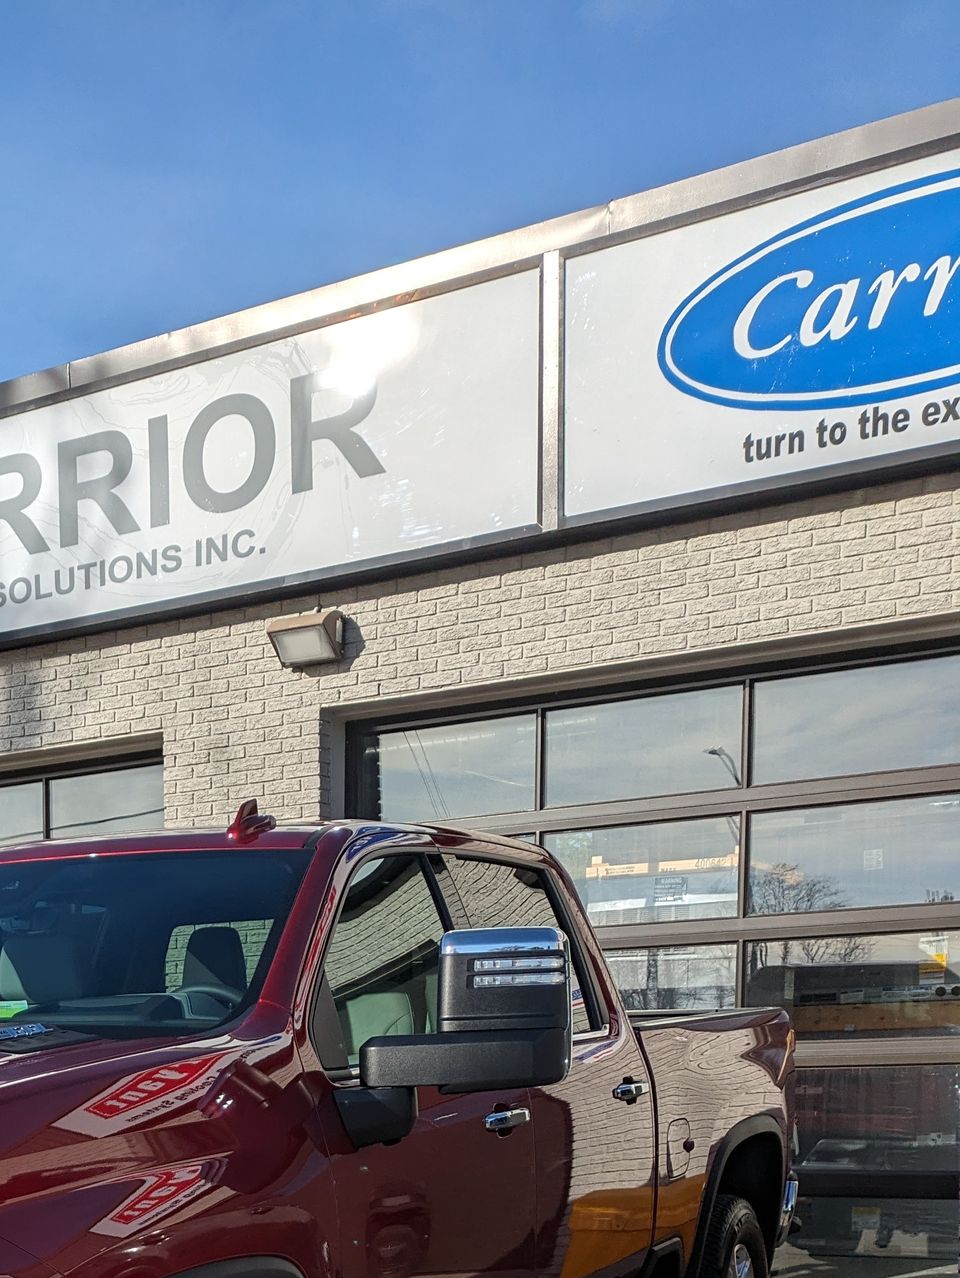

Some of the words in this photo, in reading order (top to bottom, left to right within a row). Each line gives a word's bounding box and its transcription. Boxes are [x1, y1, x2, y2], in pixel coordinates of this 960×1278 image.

[743, 428, 805, 463] turn
[816, 417, 847, 449] to
[858, 406, 910, 440] the
[195, 528, 266, 567] INC.
